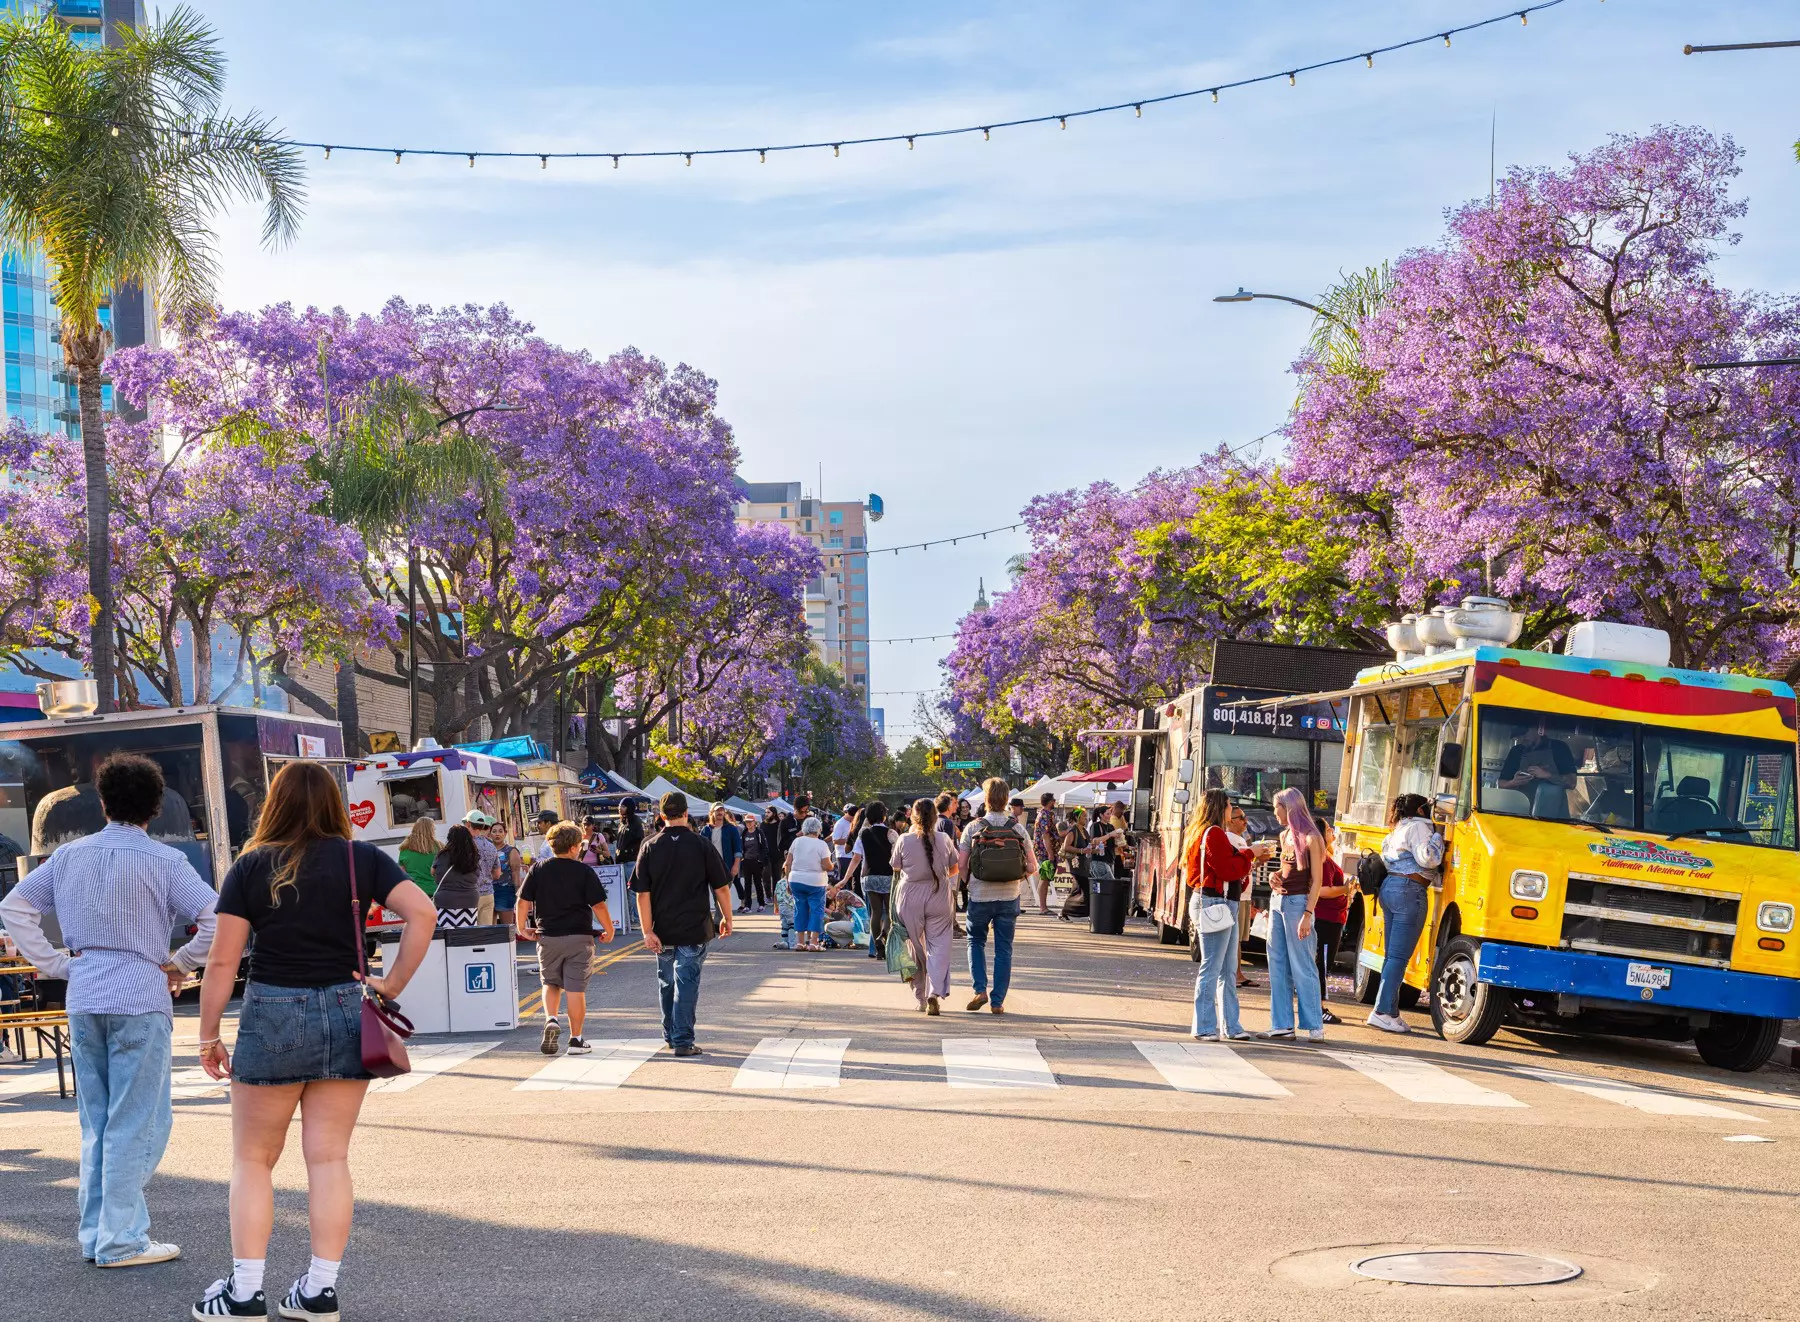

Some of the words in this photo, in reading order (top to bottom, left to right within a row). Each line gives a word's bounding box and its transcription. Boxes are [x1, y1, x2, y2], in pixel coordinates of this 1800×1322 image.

[1595, 844, 1707, 866] HERMANOS
[1601, 859, 1643, 871] Authentic
[1646, 864, 1686, 877] Mexican
[1688, 869, 1714, 880] Food
[1630, 971, 1668, 986] 5N44985
